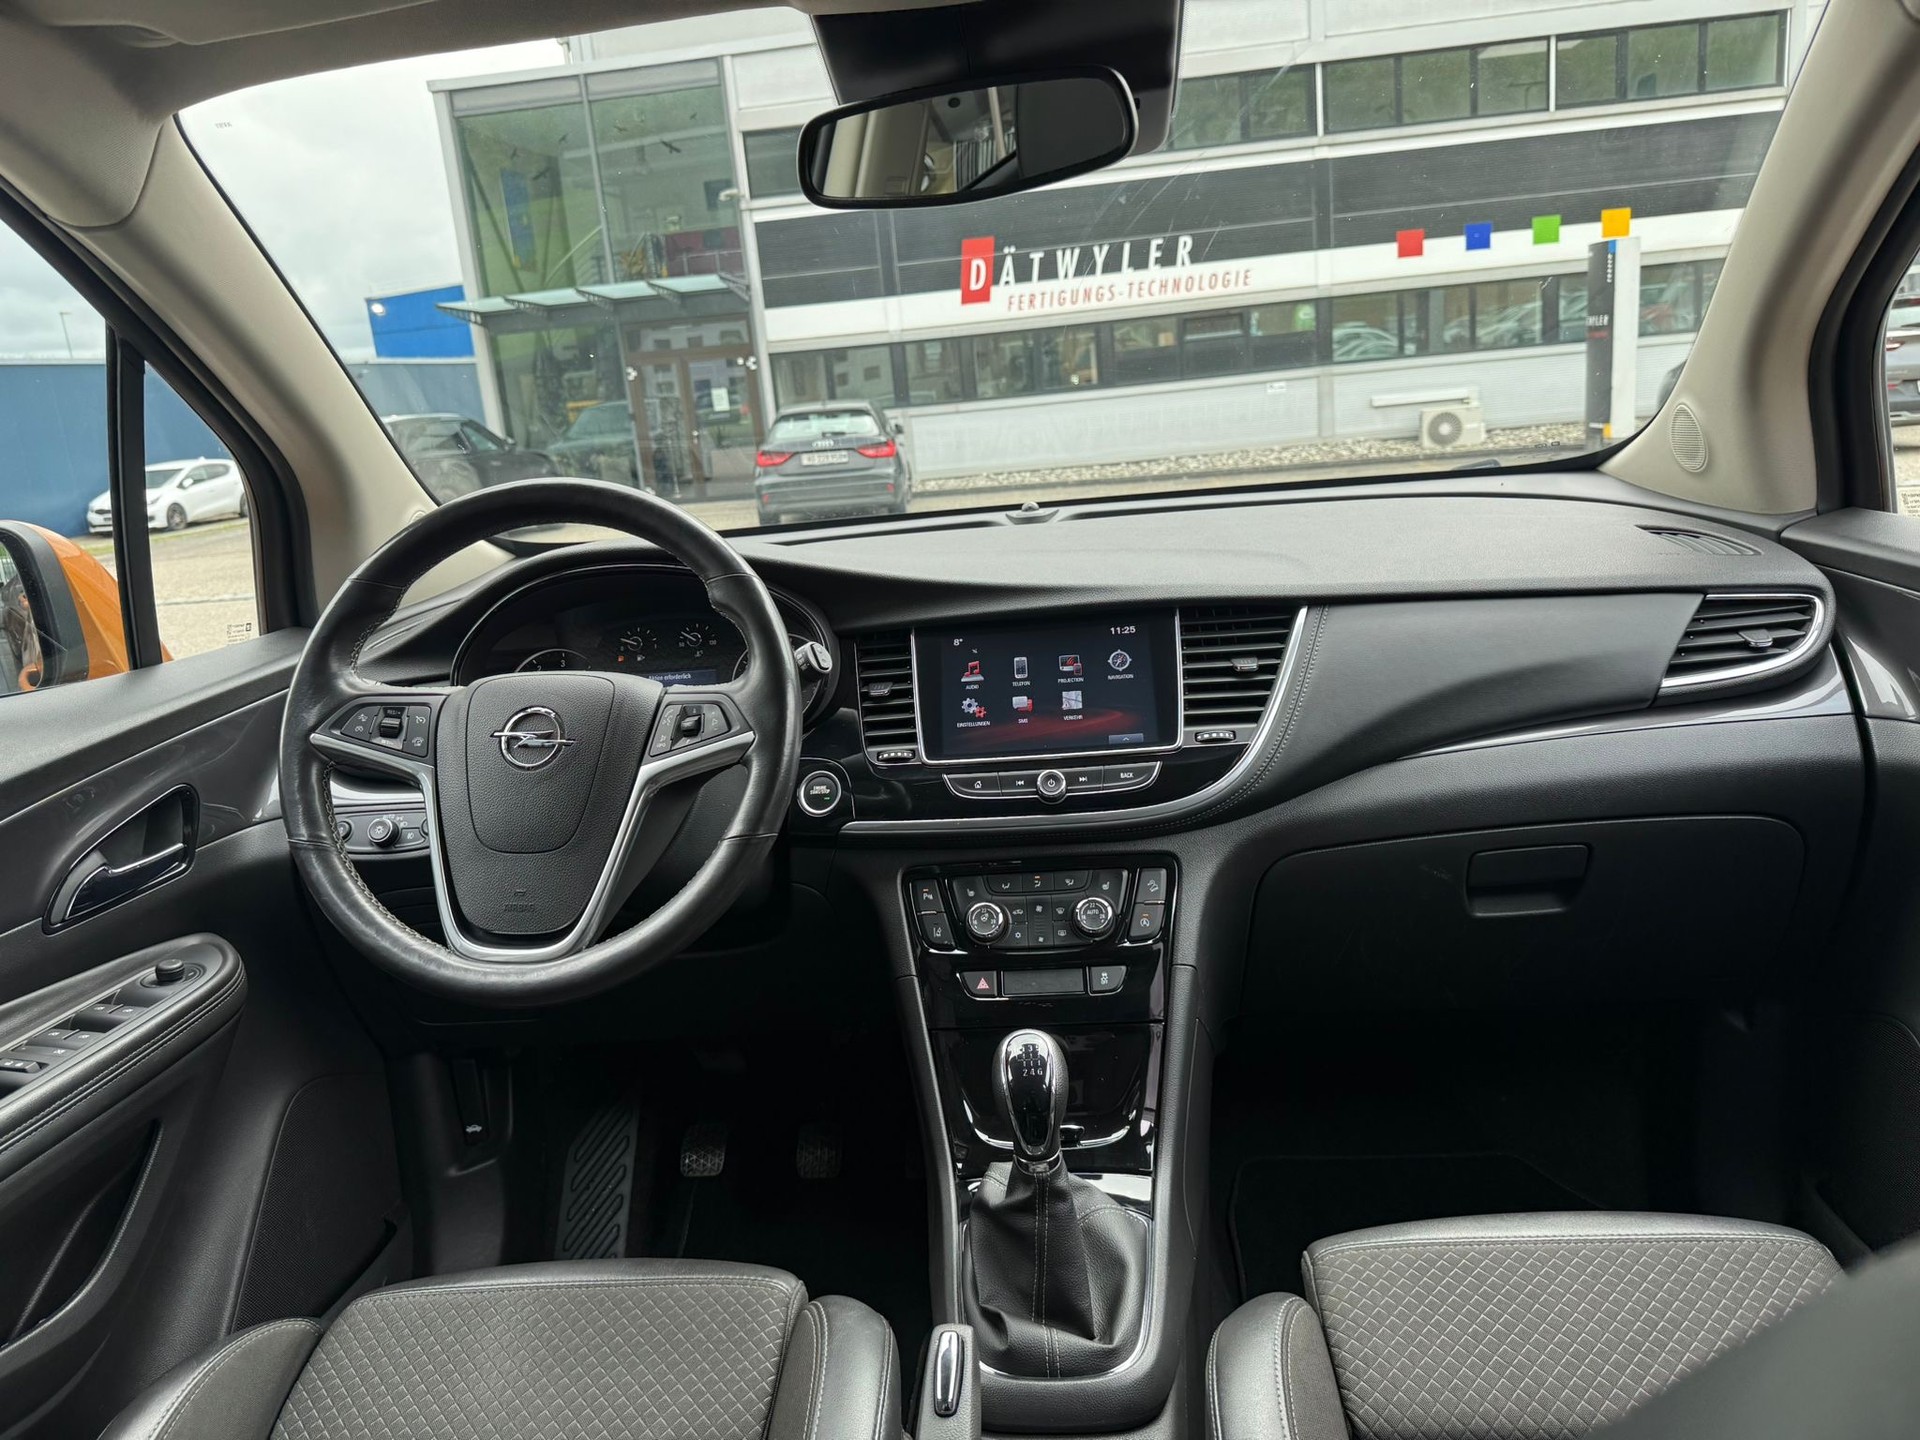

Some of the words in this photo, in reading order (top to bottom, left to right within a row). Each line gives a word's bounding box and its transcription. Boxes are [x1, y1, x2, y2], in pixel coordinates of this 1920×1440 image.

[969, 234, 1194, 291] DÄTWYLER
[1007, 268, 1252, 312] FERTIGUNGS-TECHNOLOGIE
[1110, 625, 1136, 635] 11:25
[1022, 1069, 1028, 1077] 2
